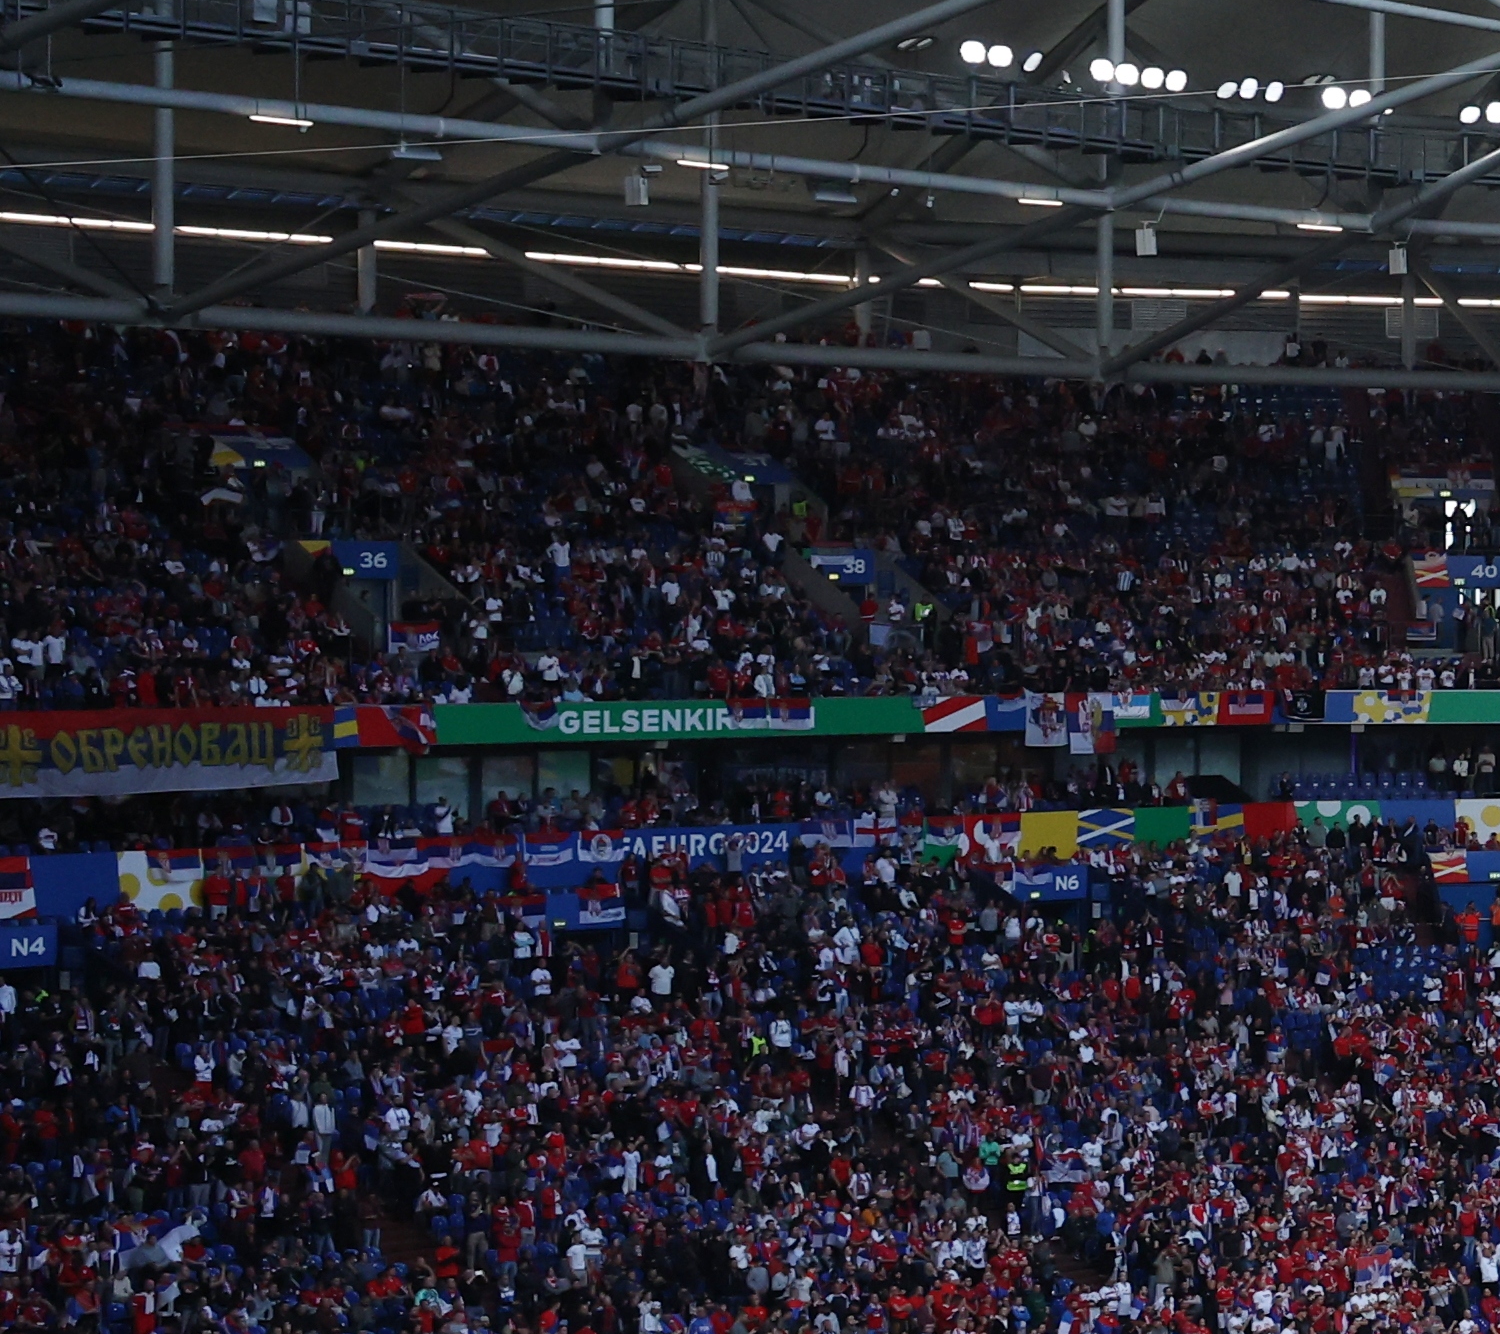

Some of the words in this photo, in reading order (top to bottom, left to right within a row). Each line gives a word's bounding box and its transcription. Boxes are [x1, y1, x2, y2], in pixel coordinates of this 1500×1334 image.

[359, 552, 387, 568] 36
[843, 559, 866, 574] 38
[1471, 565, 1497, 578] 40
[1054, 875, 1079, 891] N6
[11, 937, 46, 957] N4
